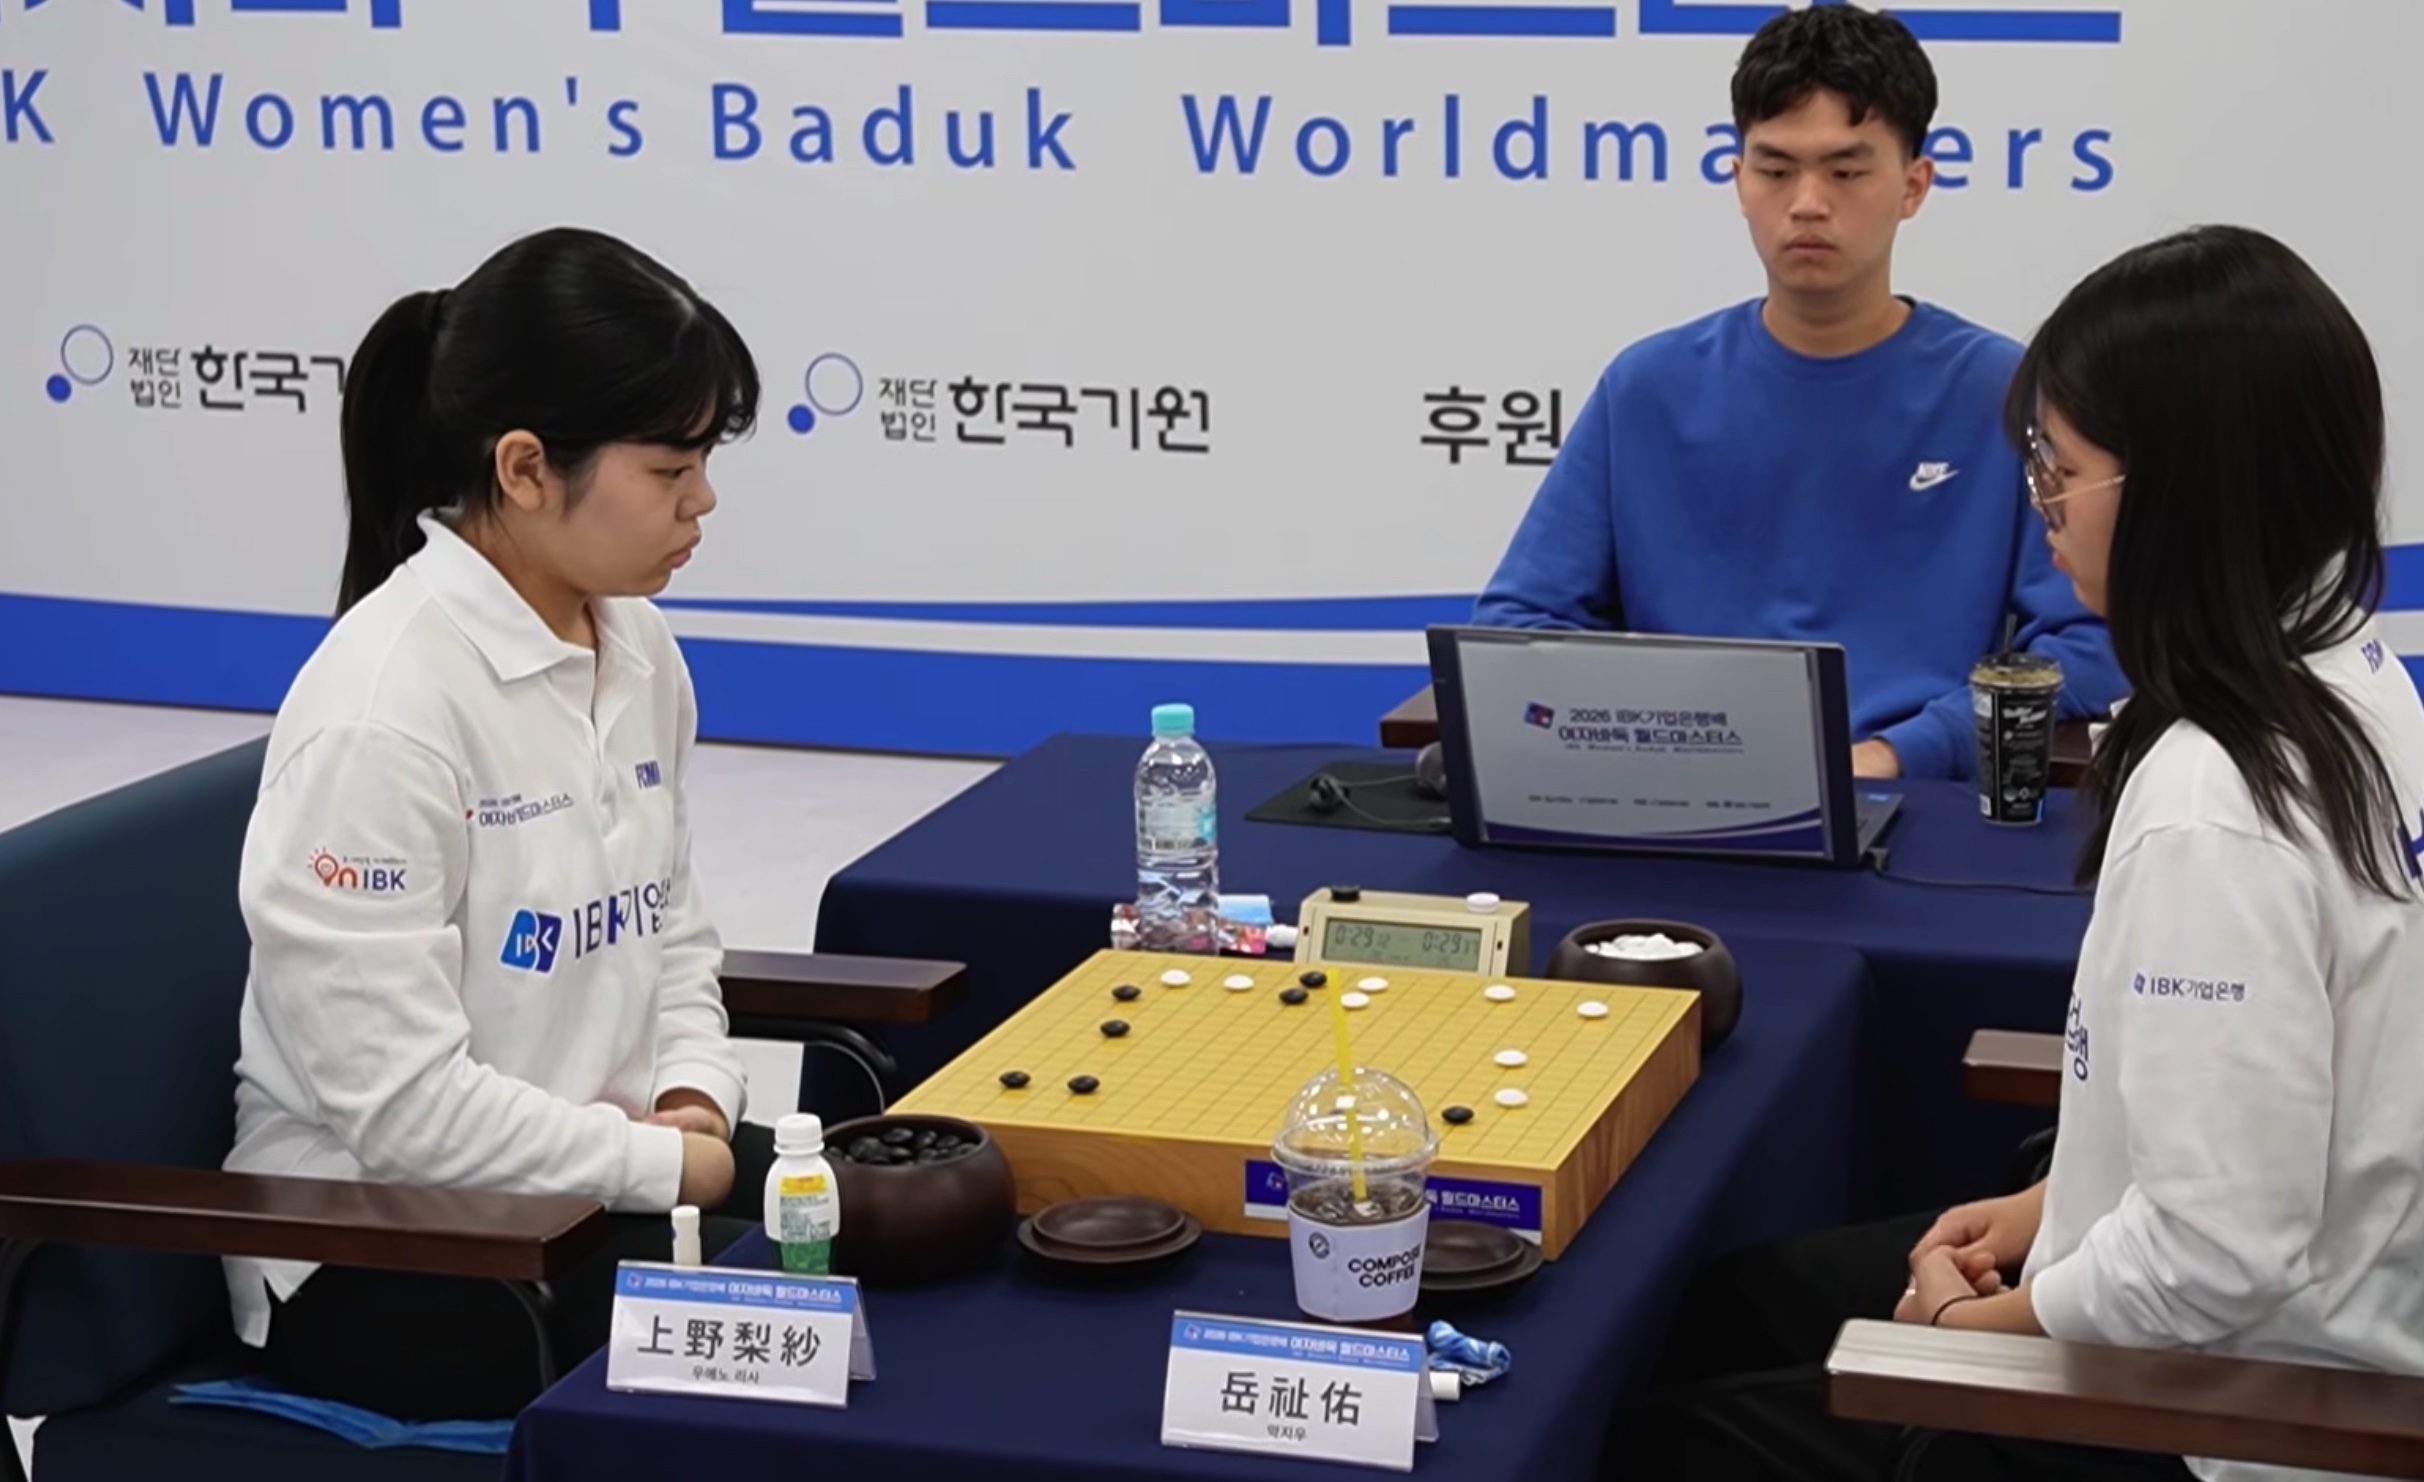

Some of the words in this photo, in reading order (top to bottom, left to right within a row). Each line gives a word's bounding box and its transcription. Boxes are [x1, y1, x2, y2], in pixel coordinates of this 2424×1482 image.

[144, 73, 643, 156] Women's
[712, 83, 1076, 170] Baduk
[1181, 95, 2114, 191] Worldmaers
[128, 347, 180, 374] 재단
[130, 380, 182, 408] 법인
[879, 377, 937, 408] 재단
[880, 411, 937, 443] 법인
[948, 375, 1210, 454] 한국기원
[1420, 385, 1562, 467] 후원
[1569, 709, 1611, 723] 2026
[363, 868, 406, 891] IBK
[2151, 977, 2245, 1002] IBK기업은행
[637, 1315, 821, 1367] 上野梨紗
[1221, 1371, 1362, 1426] 岳祉佑
